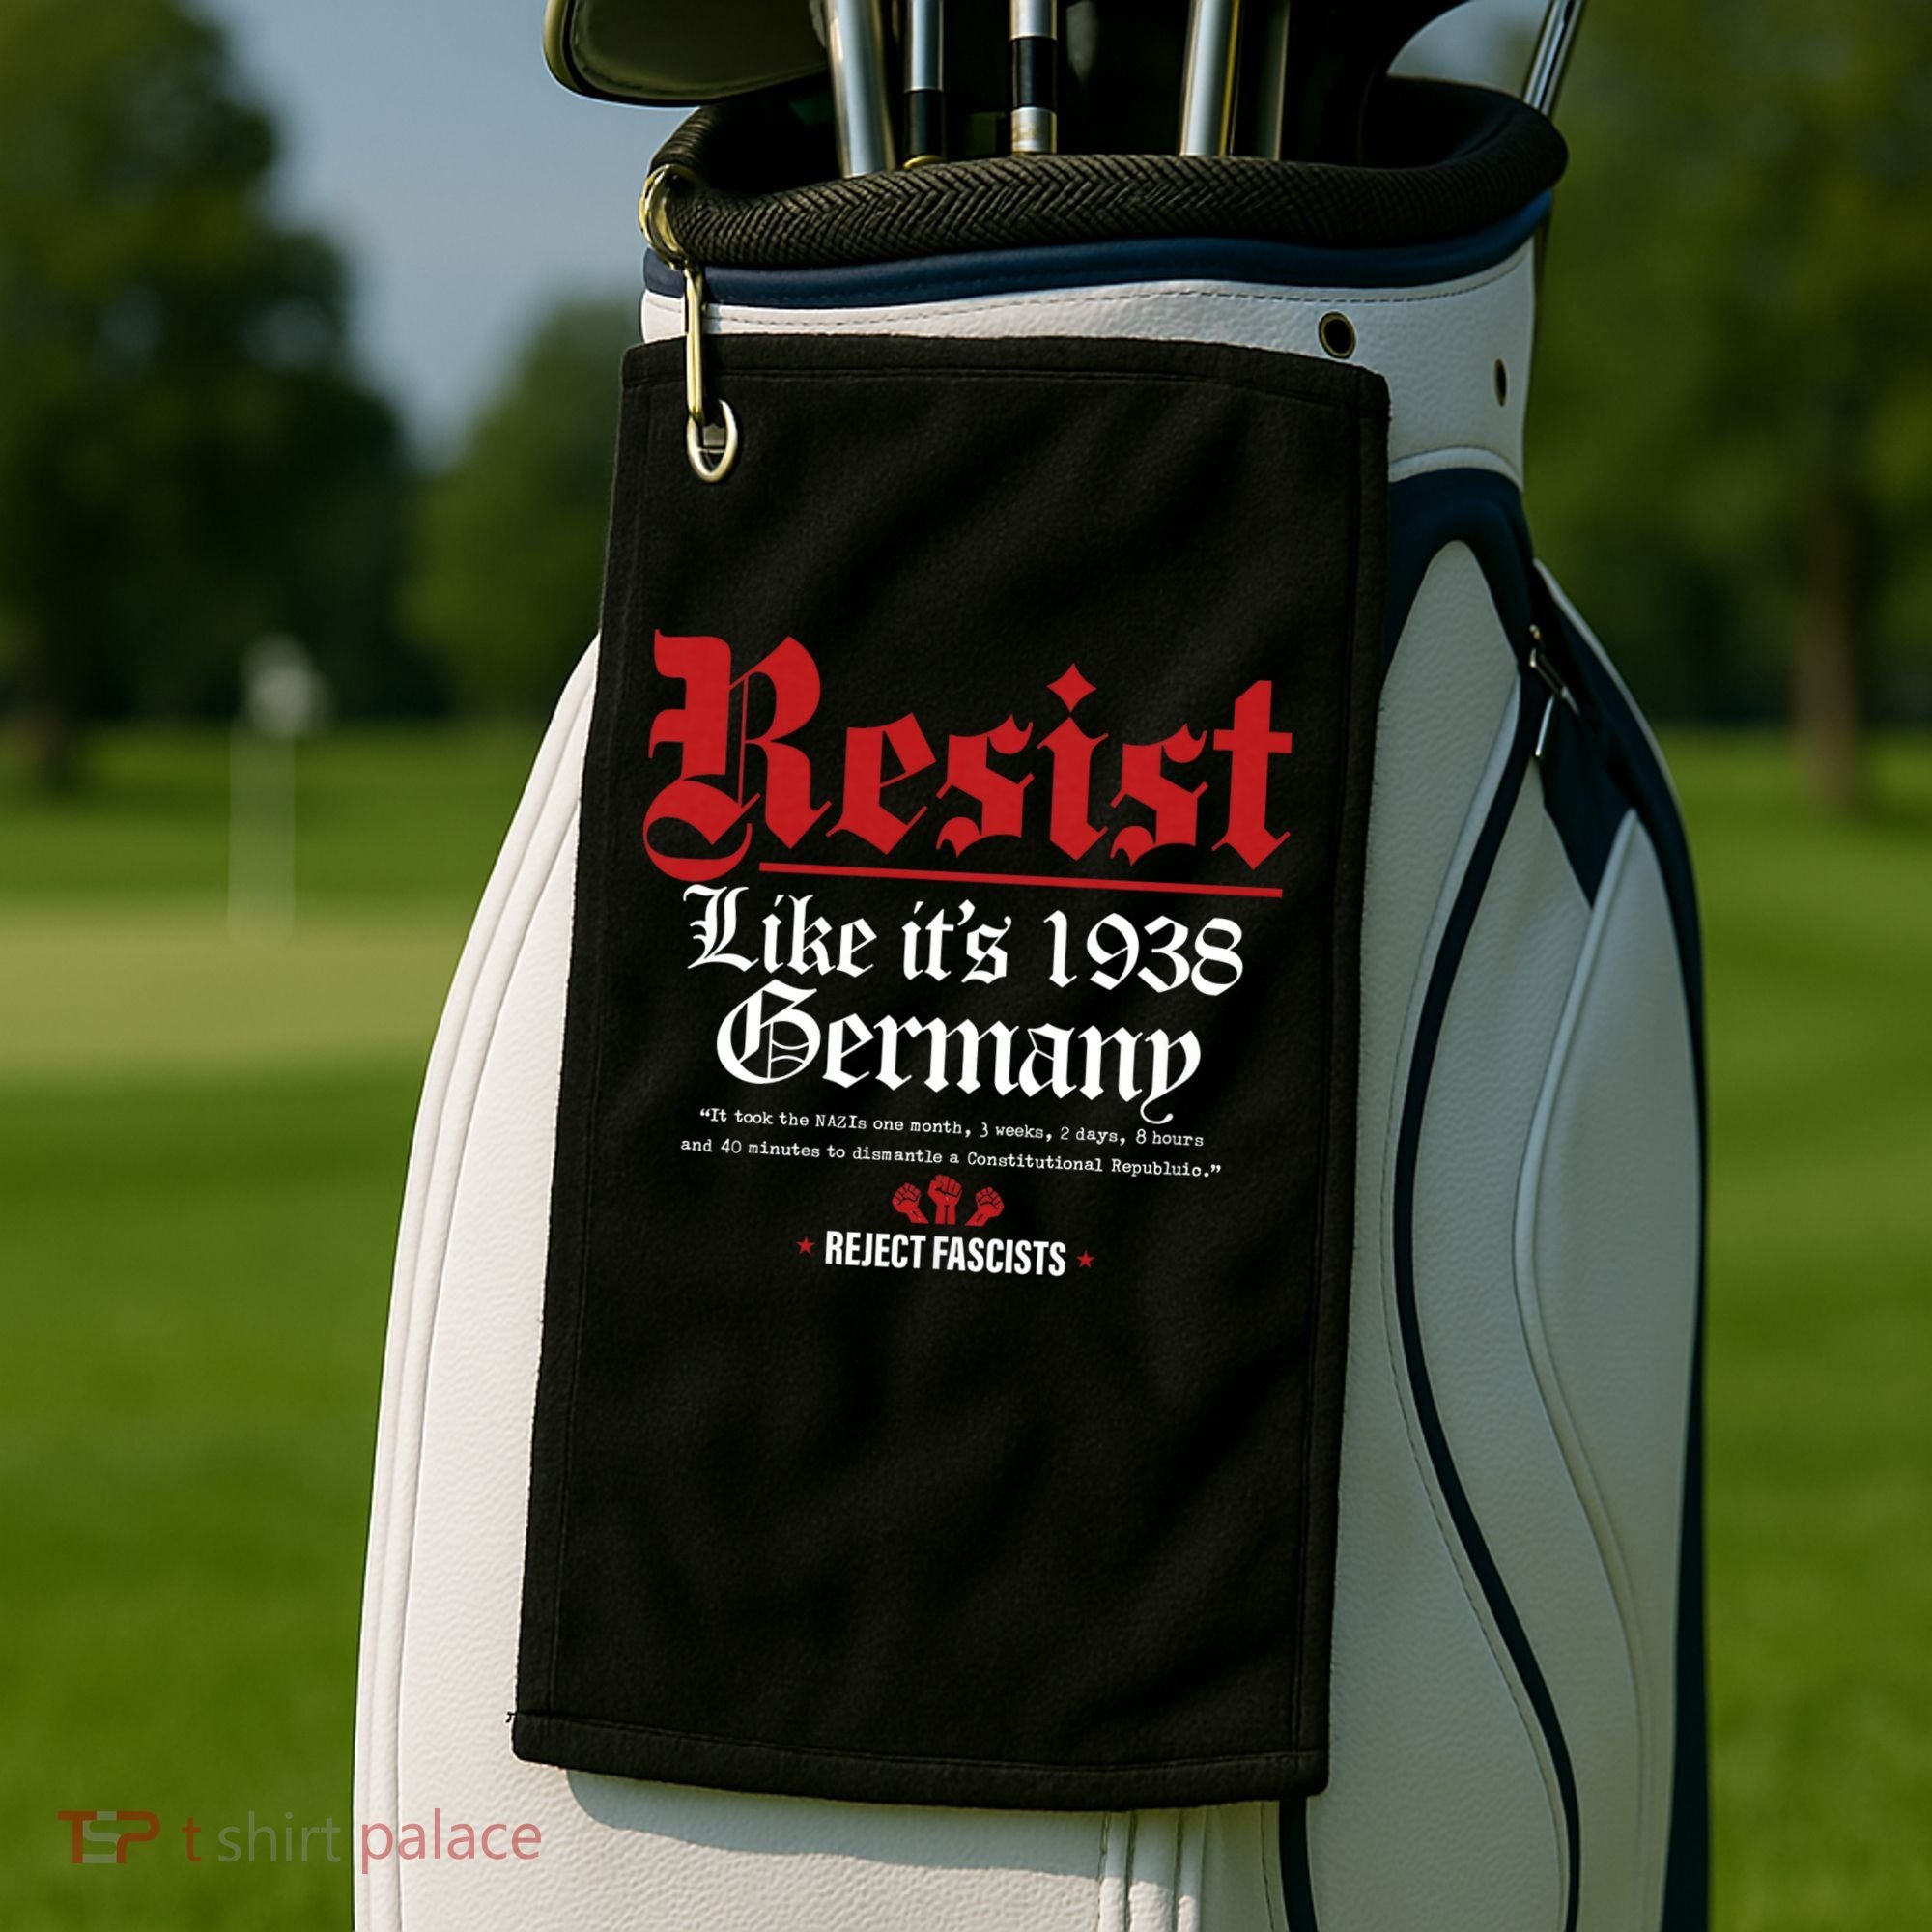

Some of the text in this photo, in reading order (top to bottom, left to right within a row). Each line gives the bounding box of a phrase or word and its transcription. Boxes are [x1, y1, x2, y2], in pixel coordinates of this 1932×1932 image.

[642, 629, 1293, 882] Resist
[682, 883, 1244, 997] Like it’s 1938
[716, 979, 1202, 1125] Germany
[680, 1138, 713, 1152] and
[720, 1138, 742, 1154] 40
[748, 1140, 820, 1158] minutes
[826, 1144, 846, 1159] to
[852, 1146, 943, 1164] dismantle
[949, 1153, 960, 1164] a
[967, 1151, 1103, 1172] Constitutional
[699, 1108, 1204, 1147] “It took the NAZIs one month, 3 weeks, 2 days, 8 hours
[825, 1230, 1066, 1277] REJECT FASCISTS
